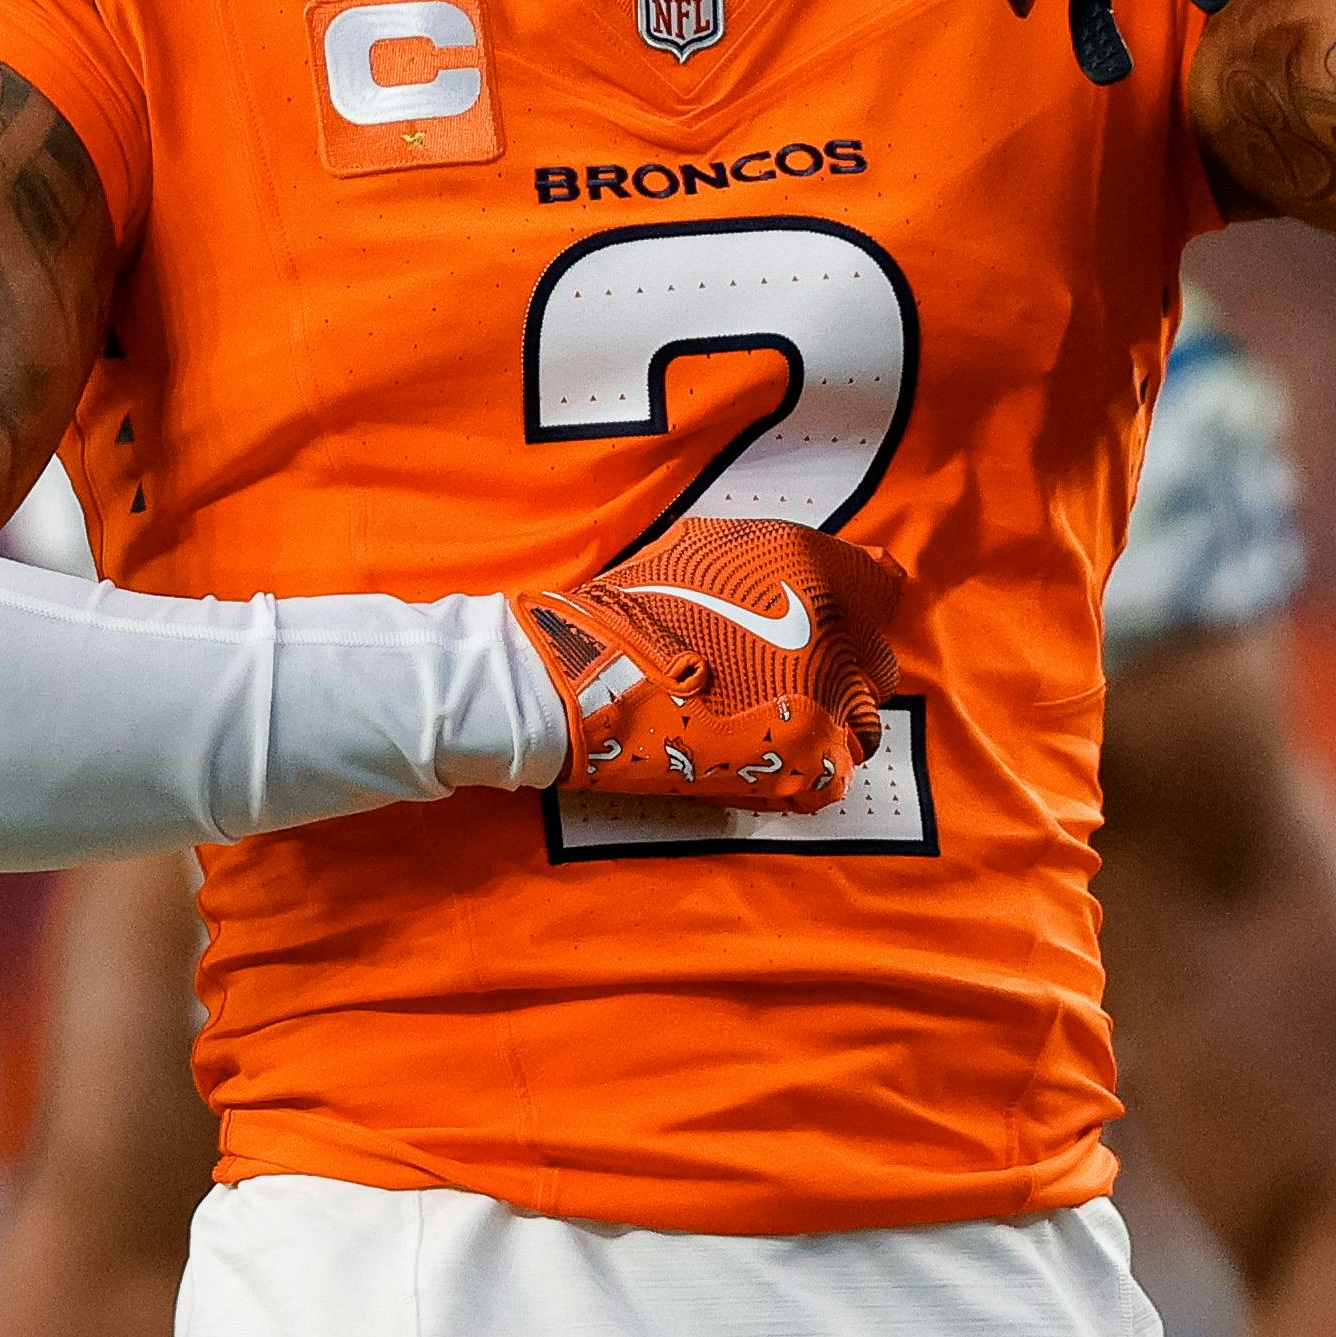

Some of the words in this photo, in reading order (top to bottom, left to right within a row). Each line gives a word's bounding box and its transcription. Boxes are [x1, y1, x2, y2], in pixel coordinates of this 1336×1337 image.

[324, 0, 482, 126] C
[534, 139, 868, 204] BRONCOS
[524, 215, 939, 864] 2
